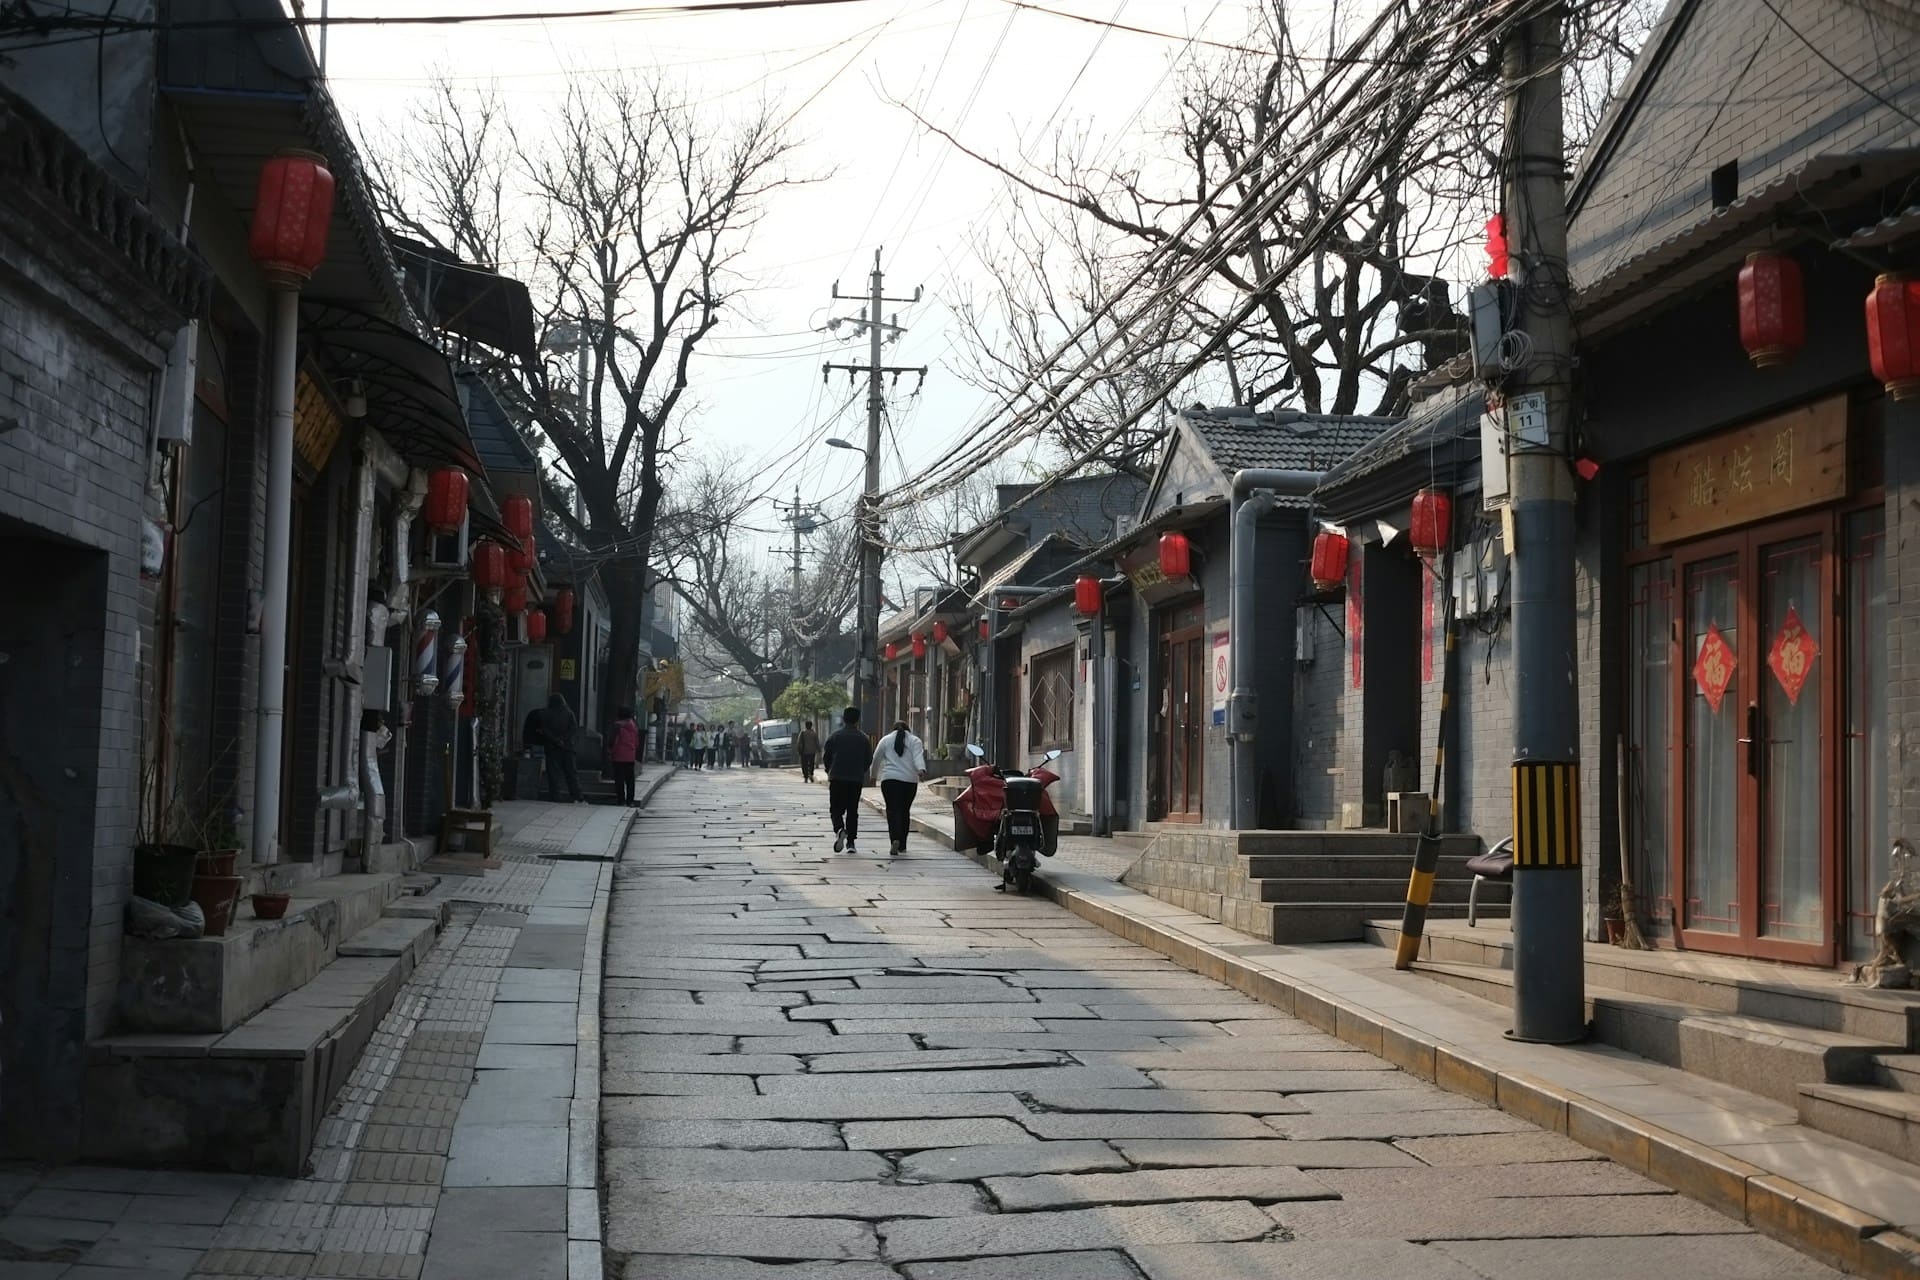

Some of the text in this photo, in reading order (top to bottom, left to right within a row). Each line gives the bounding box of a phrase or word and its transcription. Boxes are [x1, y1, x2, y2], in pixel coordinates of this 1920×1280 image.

[1519, 415, 1532, 427] 11
[1703, 639, 1726, 690] 福
[1780, 626, 1805, 678] 福
